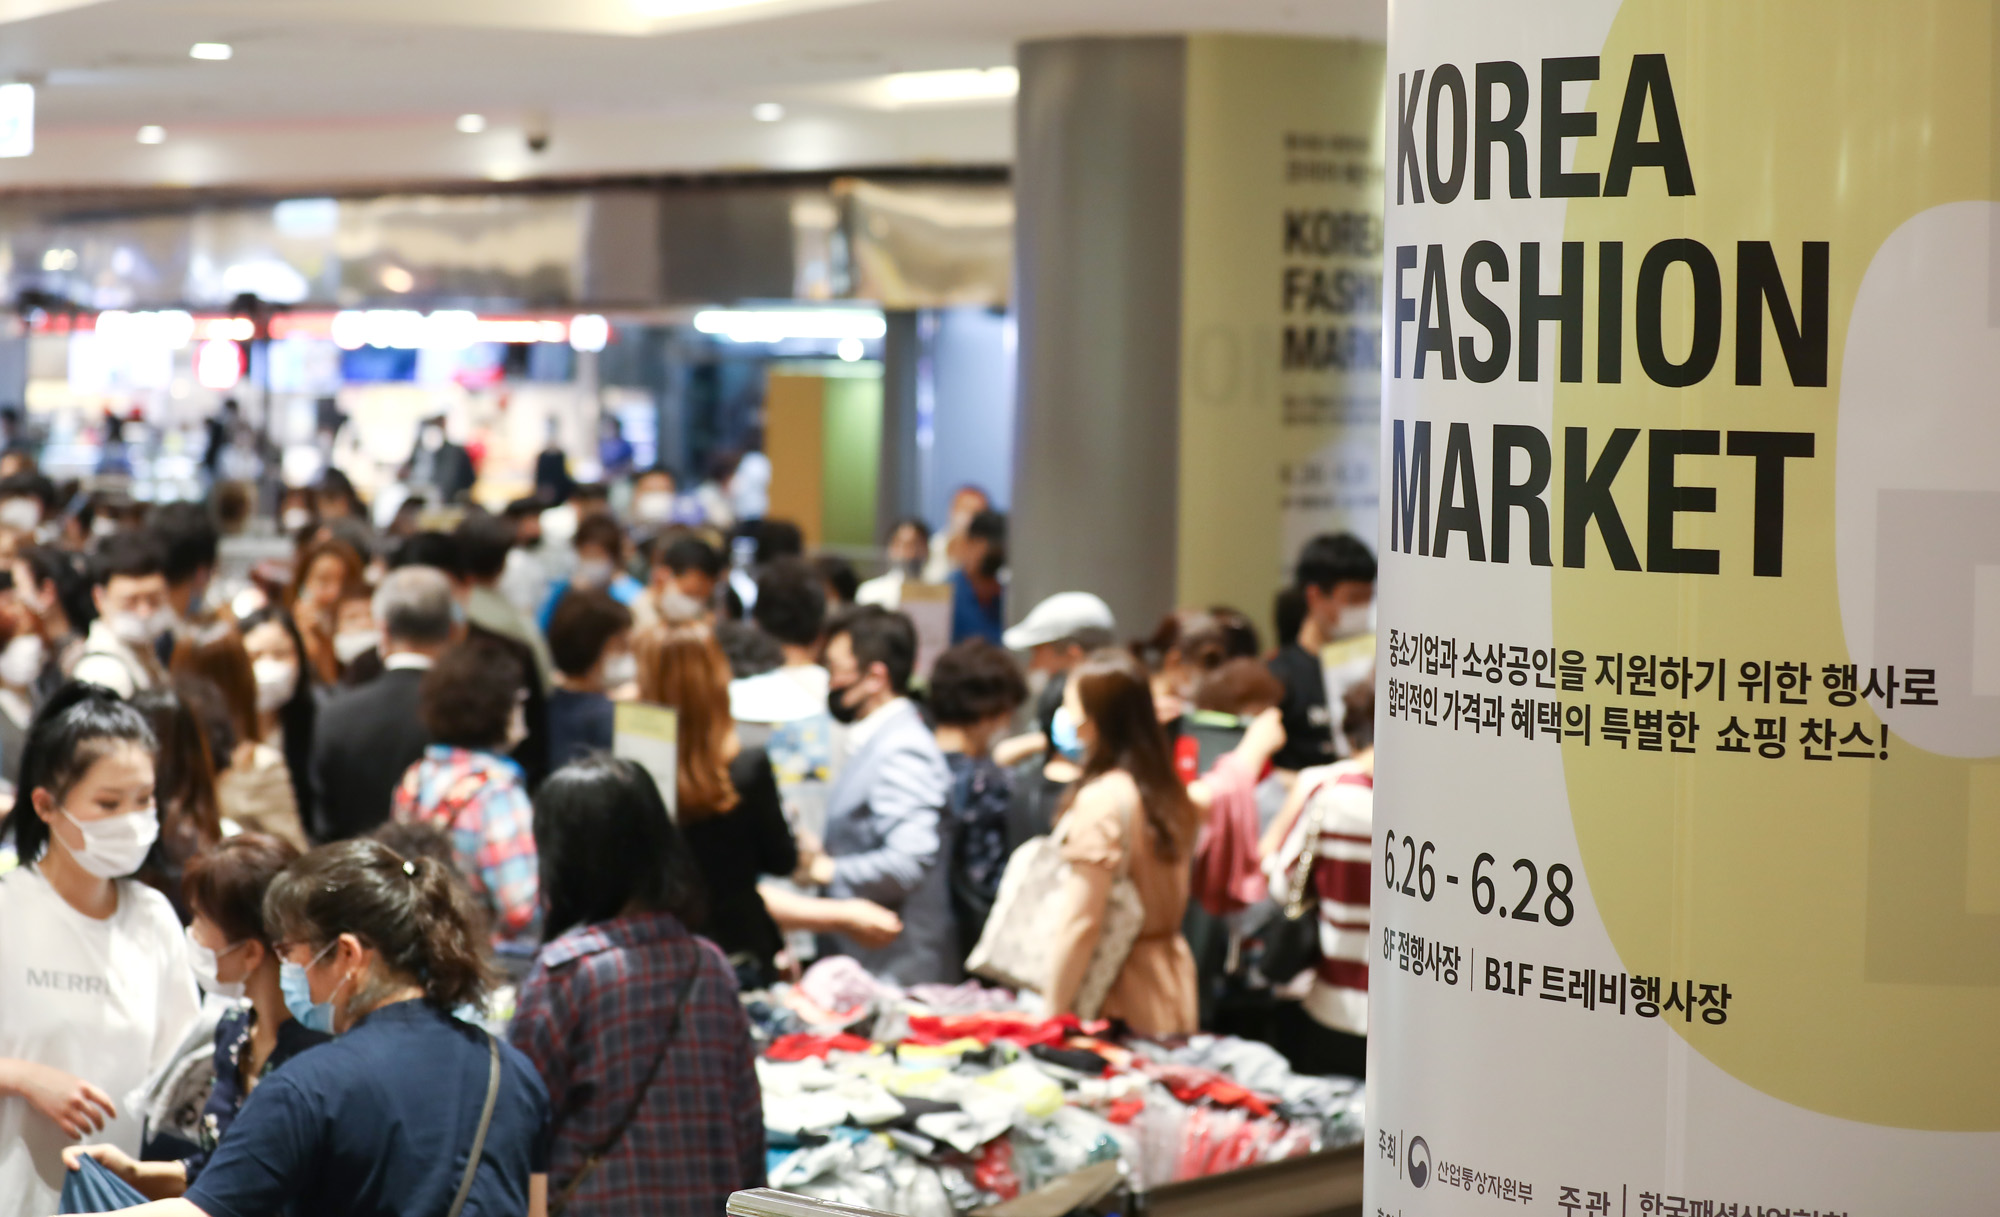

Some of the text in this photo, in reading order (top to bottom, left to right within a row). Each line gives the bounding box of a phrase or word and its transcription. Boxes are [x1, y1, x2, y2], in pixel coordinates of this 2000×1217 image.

[1397, 53, 1696, 205] KOREA
[1394, 238, 1830, 387] FASHION
[1391, 419, 1815, 578] MARKET
[1389, 628, 1939, 709] 중소기업과 소상공인을 지원하기 위한 행사로
[1388, 677, 1889, 761] 합리적인 가격과 혜택의 특별한 쇼핑 찬스!
[1384, 829, 1436, 902] 6.26
[1471, 852, 1575, 927] 6.28
[26, 967, 111, 997] MERR
[1382, 926, 1732, 1025] 8F 점행사장 B1F 트레비행사장
[1378, 1128, 1534, 1205] 주최 산업통상자원부
